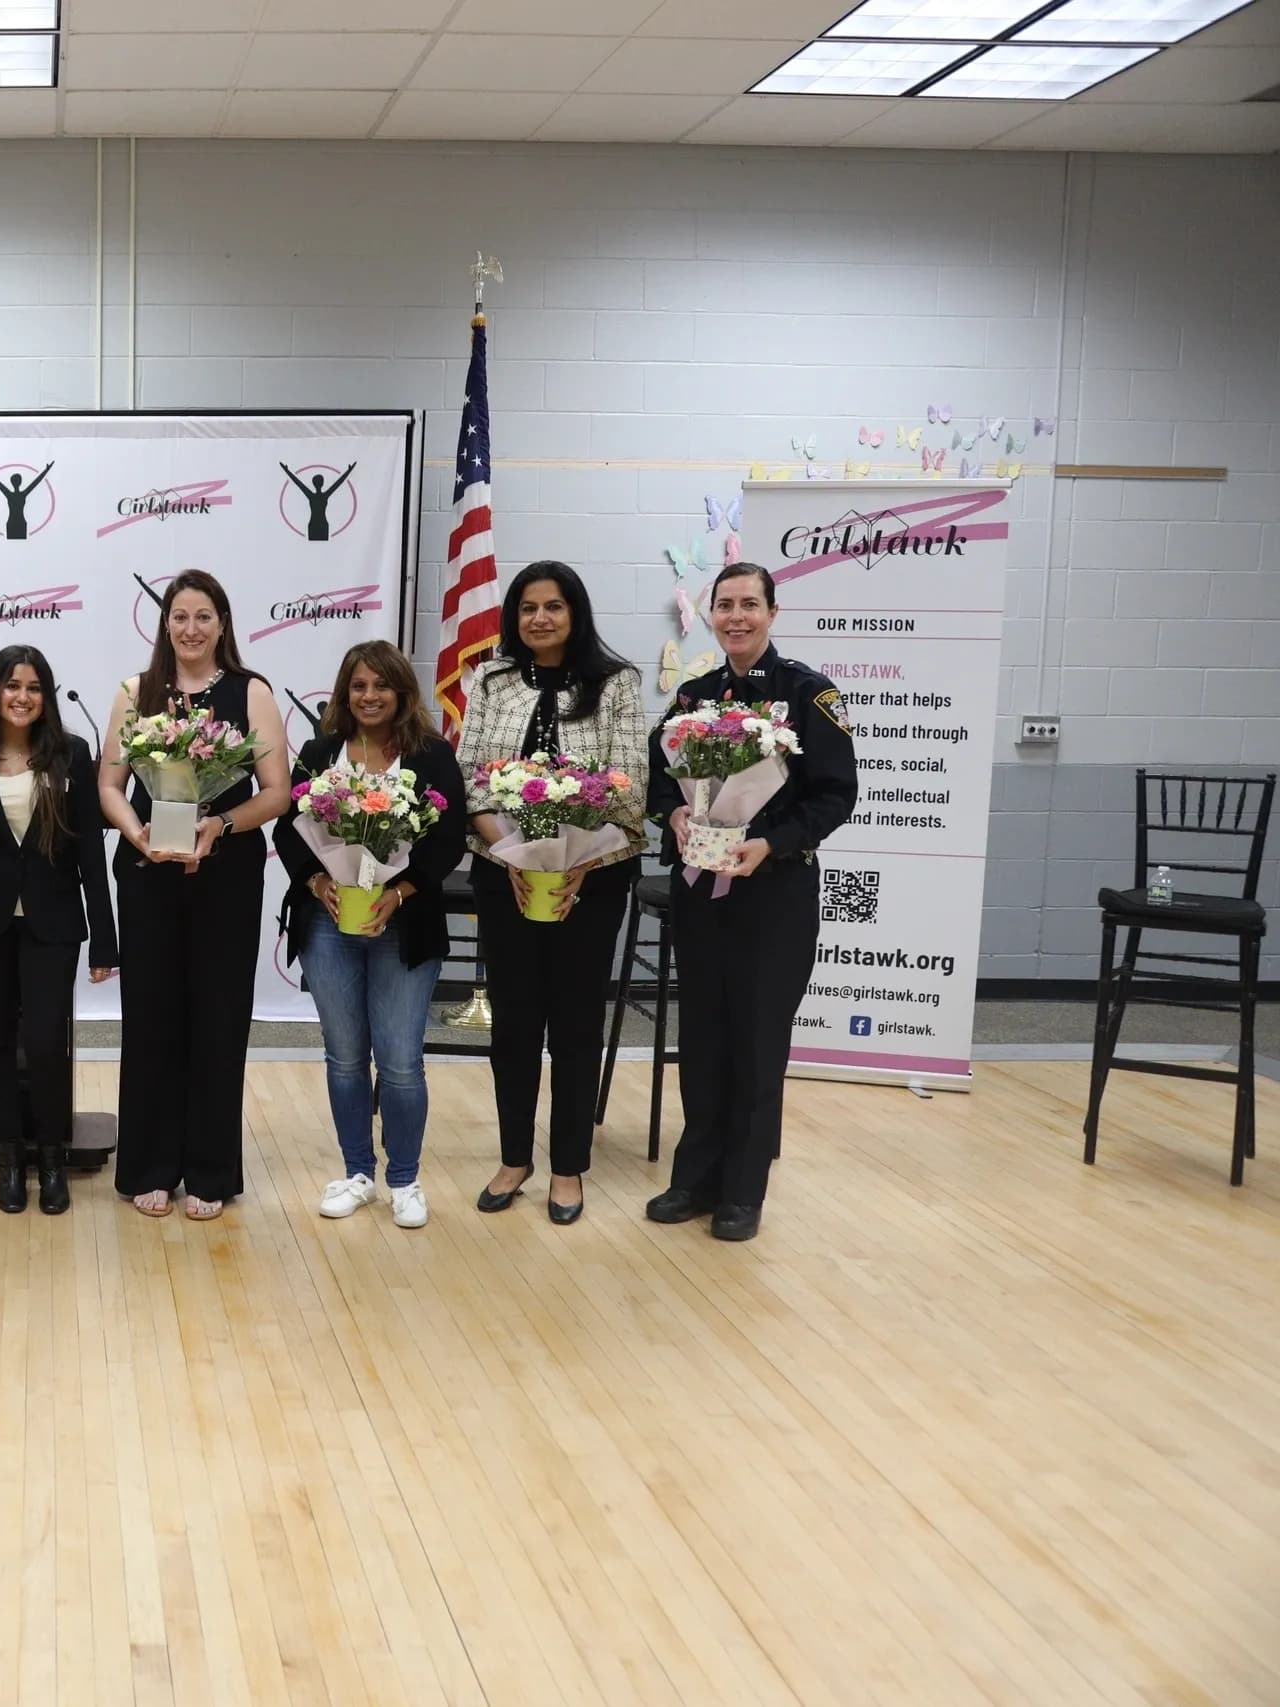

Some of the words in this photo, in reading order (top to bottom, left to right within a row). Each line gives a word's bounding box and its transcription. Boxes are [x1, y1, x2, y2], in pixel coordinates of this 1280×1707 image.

[780, 525, 967, 563] Girlstawk
[817, 618, 847, 631] OUR
[852, 618, 915, 631] MISSION
[821, 663, 905, 680] GIRLSTAWK,
[840, 692, 875, 705] etter
[880, 691, 909, 706] that
[912, 692, 952, 710] helps
[872, 723, 908, 738] bond
[912, 724, 968, 744] through
[901, 757, 947, 773] social,
[867, 787, 950, 804] intellectual
[876, 811, 946, 828] interests.
[817, 943, 954, 976] irlstawk.org
[805, 983, 940, 1007] tives@girlstawk.org
[878, 1021, 936, 1036] girlstawk.
